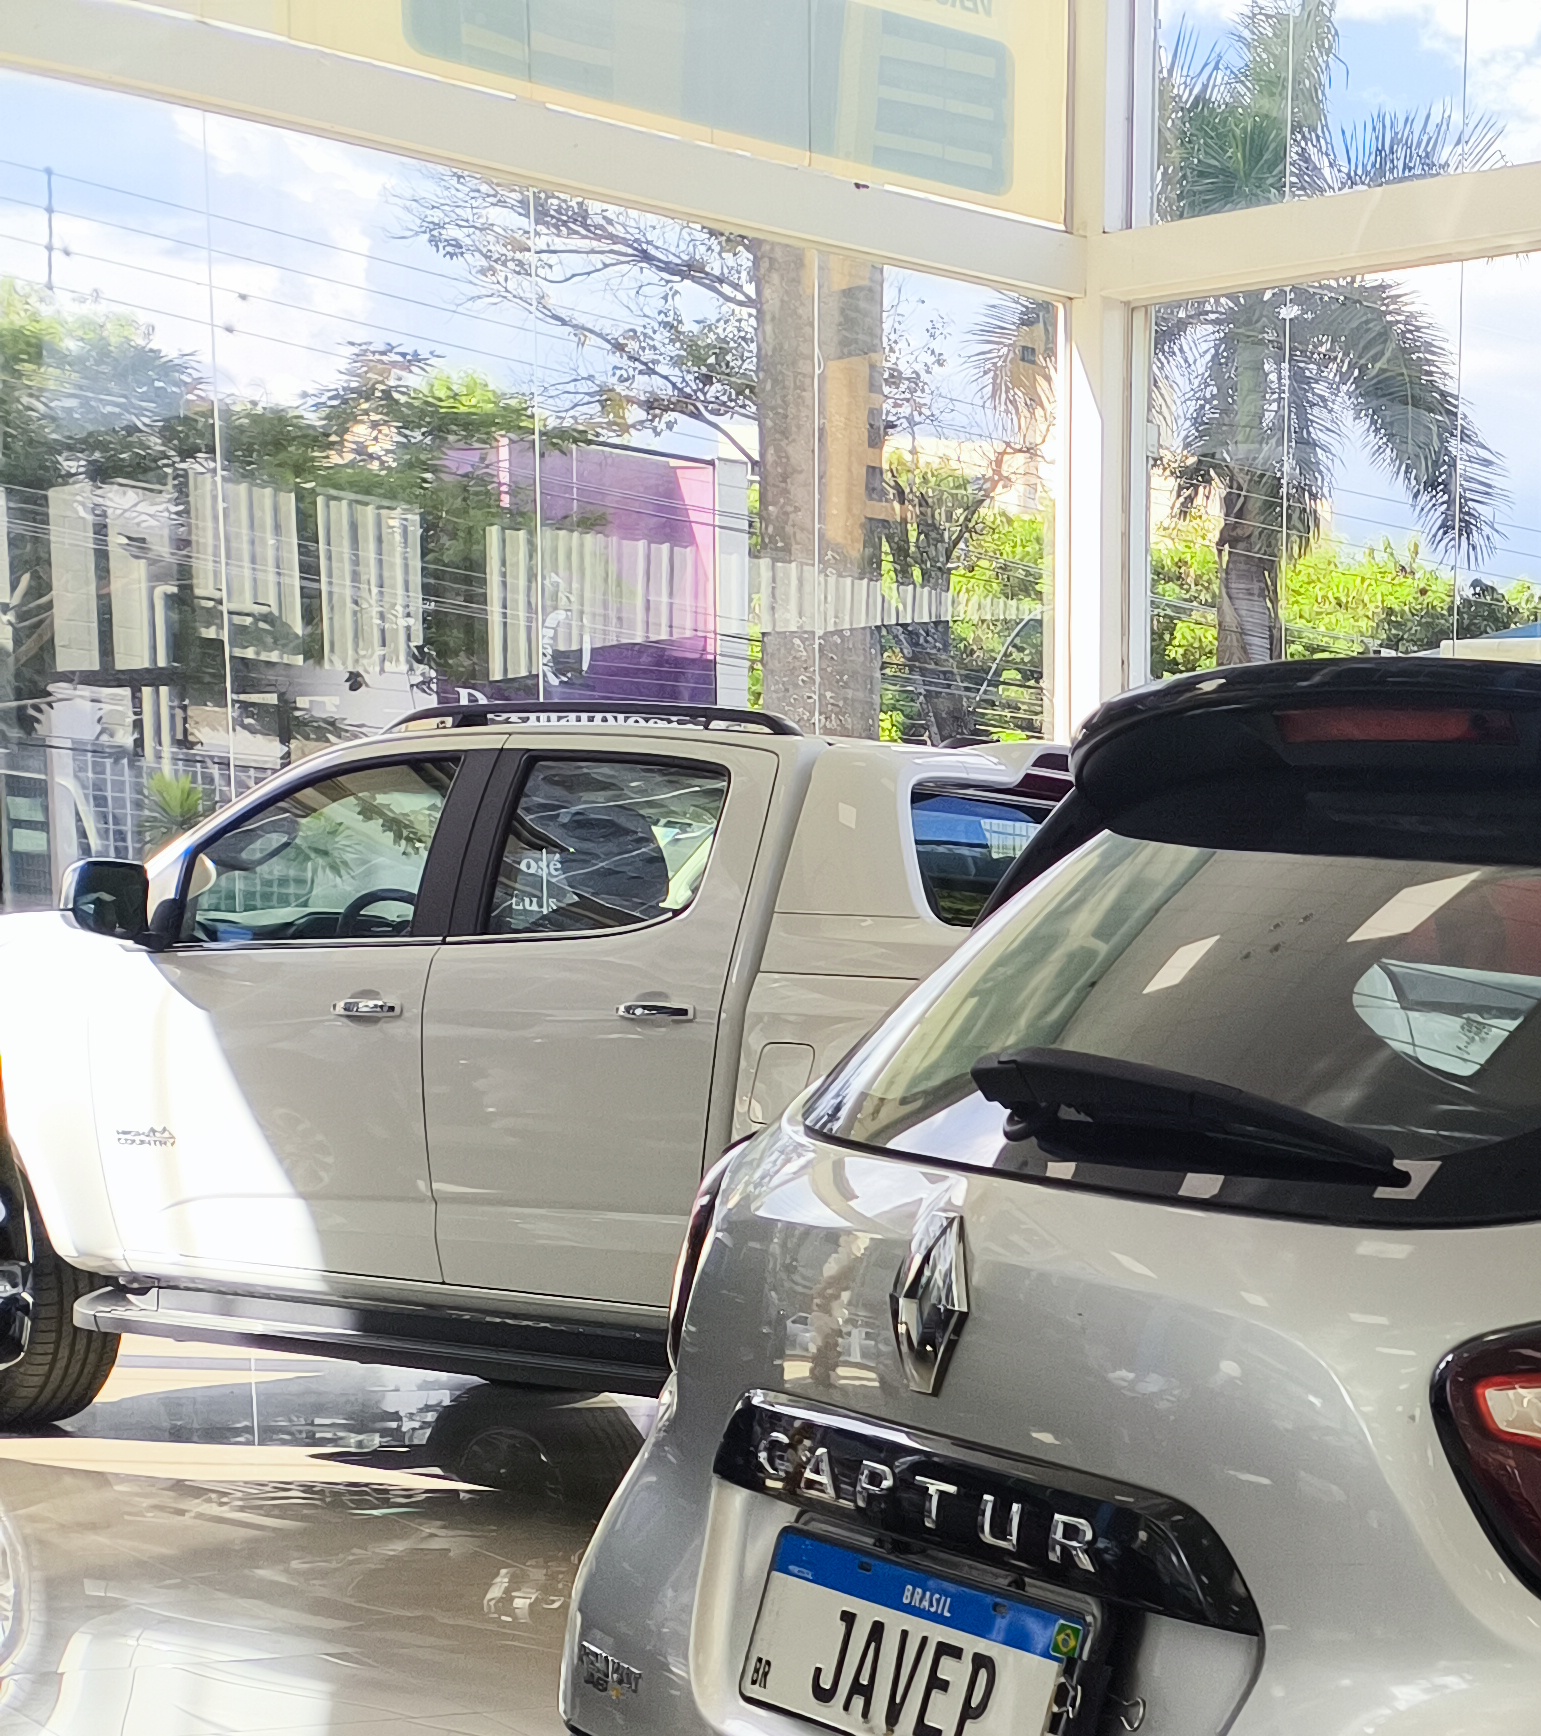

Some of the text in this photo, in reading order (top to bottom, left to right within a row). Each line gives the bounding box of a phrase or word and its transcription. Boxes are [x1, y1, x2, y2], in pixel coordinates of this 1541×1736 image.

[756, 1430, 1100, 1574] CAPTUR
[902, 1584, 952, 1618] BRASIL
[749, 1655, 773, 1691] BR
